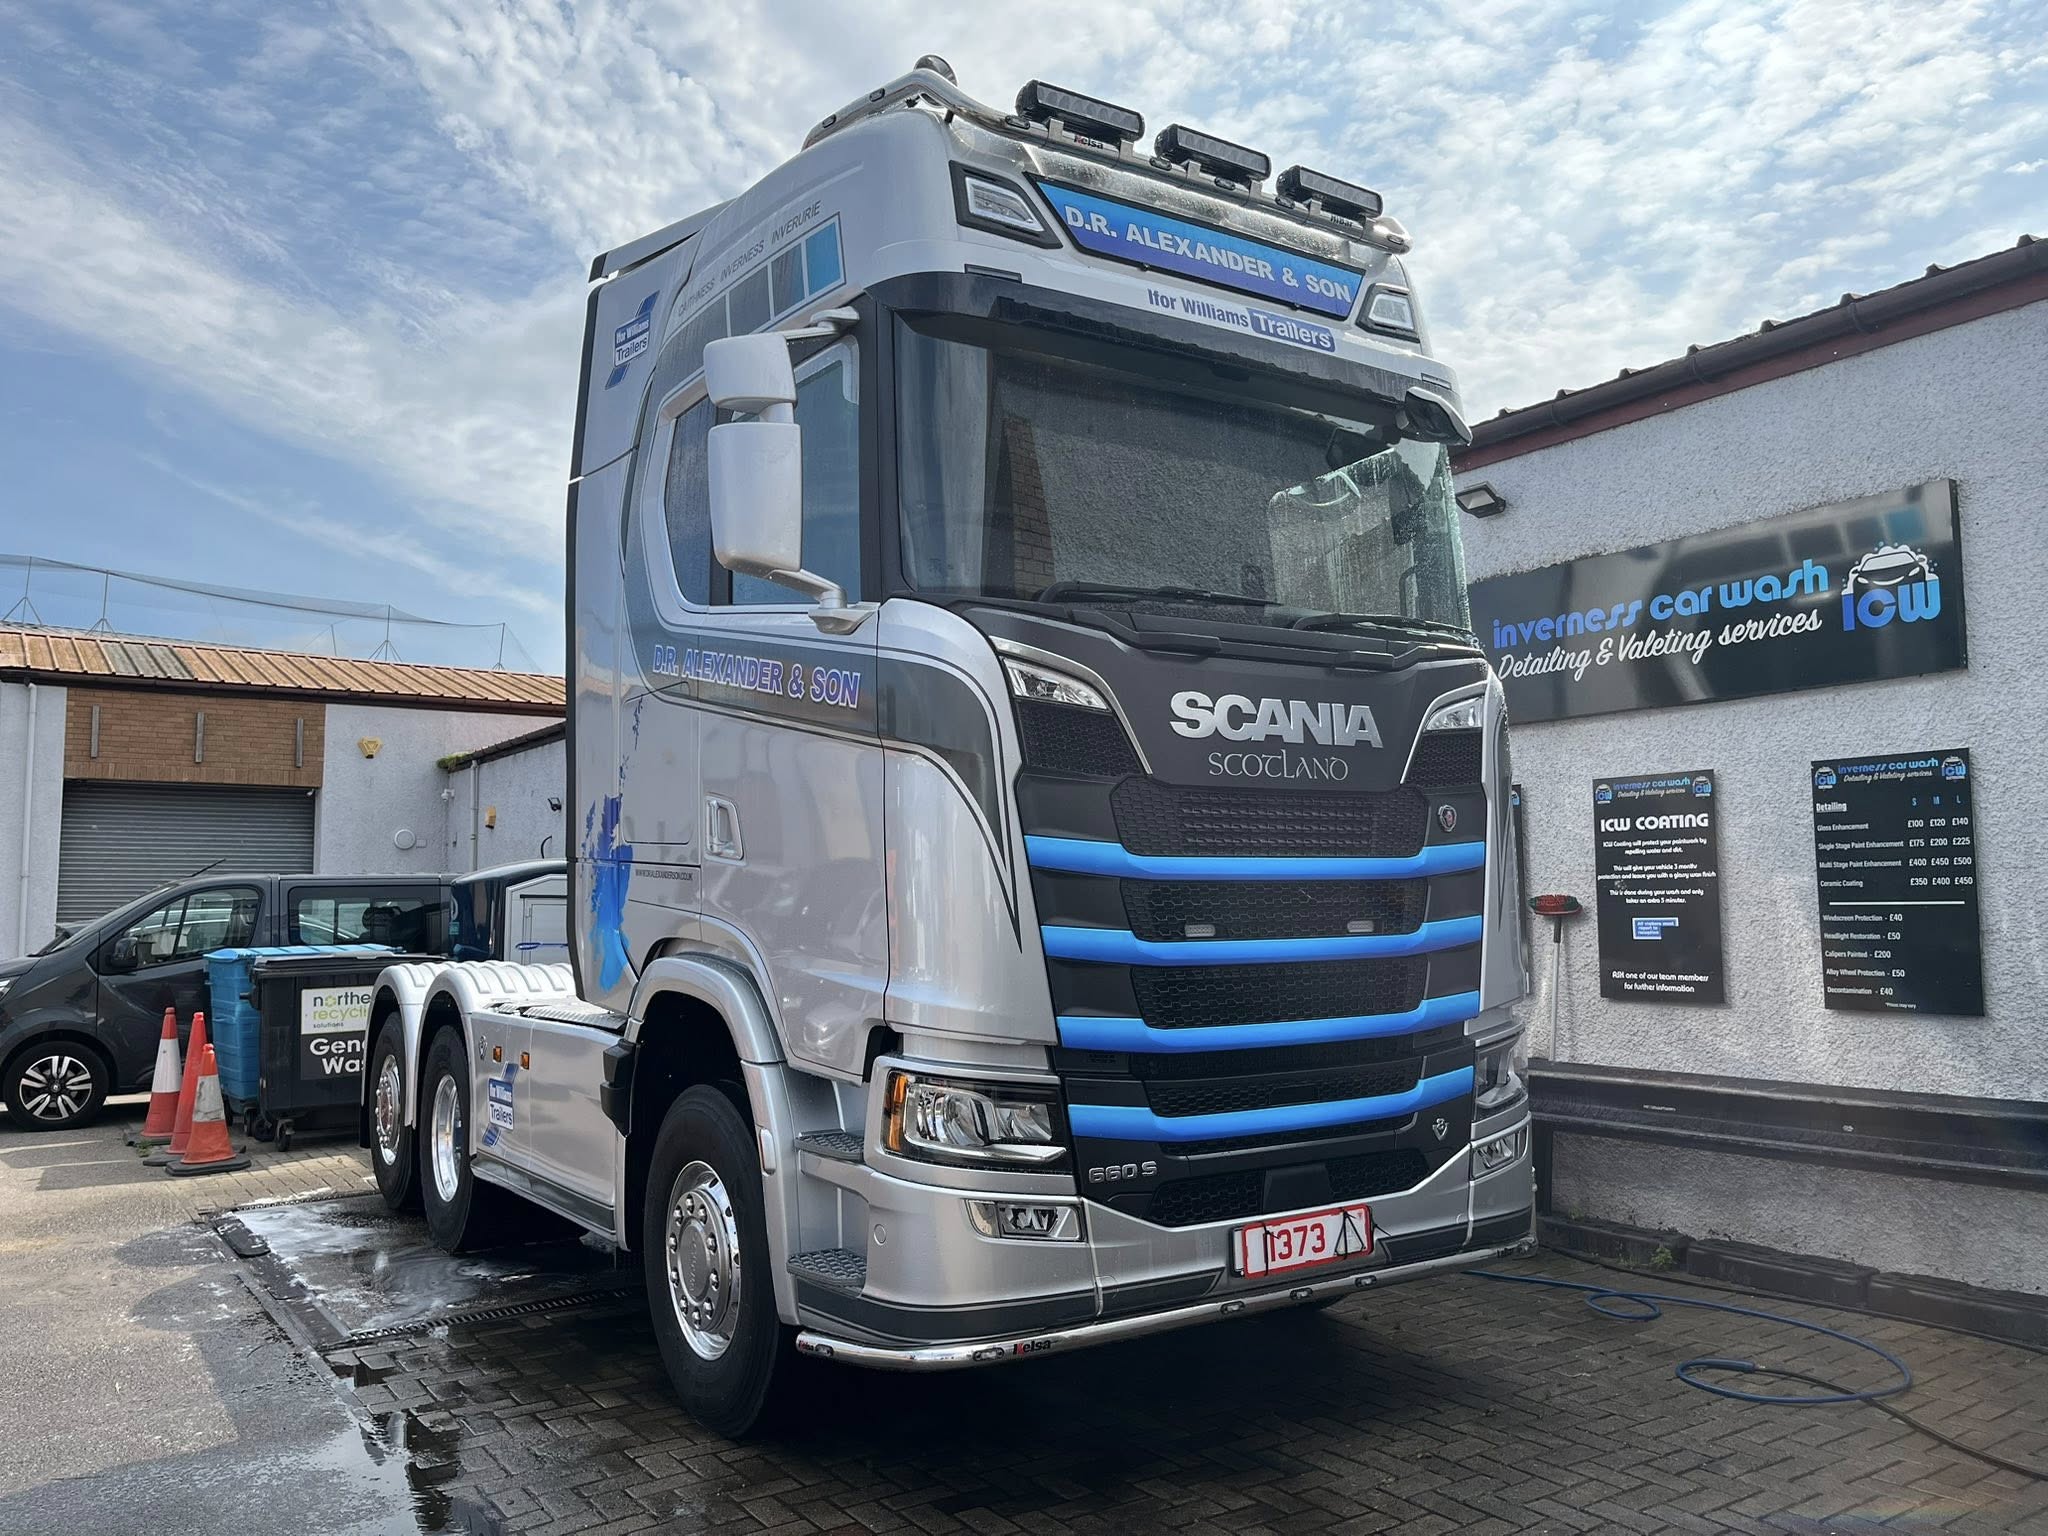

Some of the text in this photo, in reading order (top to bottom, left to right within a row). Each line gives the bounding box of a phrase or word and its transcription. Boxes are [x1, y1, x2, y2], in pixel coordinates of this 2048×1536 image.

[771, 200, 822, 244] INVERURIE
[720, 239, 765, 282] INVERNESS
[1064, 205, 1350, 303] D.R. ALEXANDER & SON
[1147, 288, 1249, 328] Ifor Williams
[1253, 313, 1332, 349] Trailers
[616, 337, 648, 361] Trailers
[1493, 558, 1829, 649] inverness car wash
[1498, 607, 1822, 682] Detailing & Valeting services
[653, 644, 861, 709] D.R. ALEXANDER & SON
[1169, 690, 1384, 749] SCANIA
[1208, 749, 1349, 781] SCOTLAND
[1838, 757, 1939, 775] inverness car wash
[1613, 777, 1690, 791] inverness car wash
[1816, 802, 1848, 813] Detailing
[1911, 795, 1961, 806] S M L
[1600, 813, 1709, 833] ICW COATING
[1832, 823, 1869, 832] Enhancement
[1907, 819, 1924, 828] £100
[1929, 818, 1946, 827] £120
[1952, 817, 1969, 826] £140
[1818, 837, 1971, 851] Single Stage Paint Enhancement £175 £200 £225
[1832, 860, 1848, 869] Stage
[1849, 860, 1863, 868] Paint
[1864, 859, 1902, 868] Enhancement
[1909, 858, 1927, 867] £400
[1931, 857, 1949, 866] £450
[1953, 856, 1972, 866] £500
[1820, 876, 1974, 888] Ceramic Coating £350 £400 £450
[1823, 913, 1903, 922] Windscreen Protection £40
[1824, 933, 1849, 941] Headlight
[1887, 932, 1901, 941] £50
[1825, 950, 1847, 960] Calipers
[1874, 950, 1891, 959] £200
[1658, 972, 1676, 981] team
[1677, 974, 1709, 982] members
[1826, 969, 1905, 978] Alloy Wheel Protection £50
[1623, 982, 1633, 990] for
[1634, 982, 1655, 991] further
[1827, 986, 1893, 996] Decontamination £40
[313, 1021, 344, 1029] solutions
[490, 1103, 513, 1126] Trailers
[1012, 1339, 1051, 1356] Kelsa
